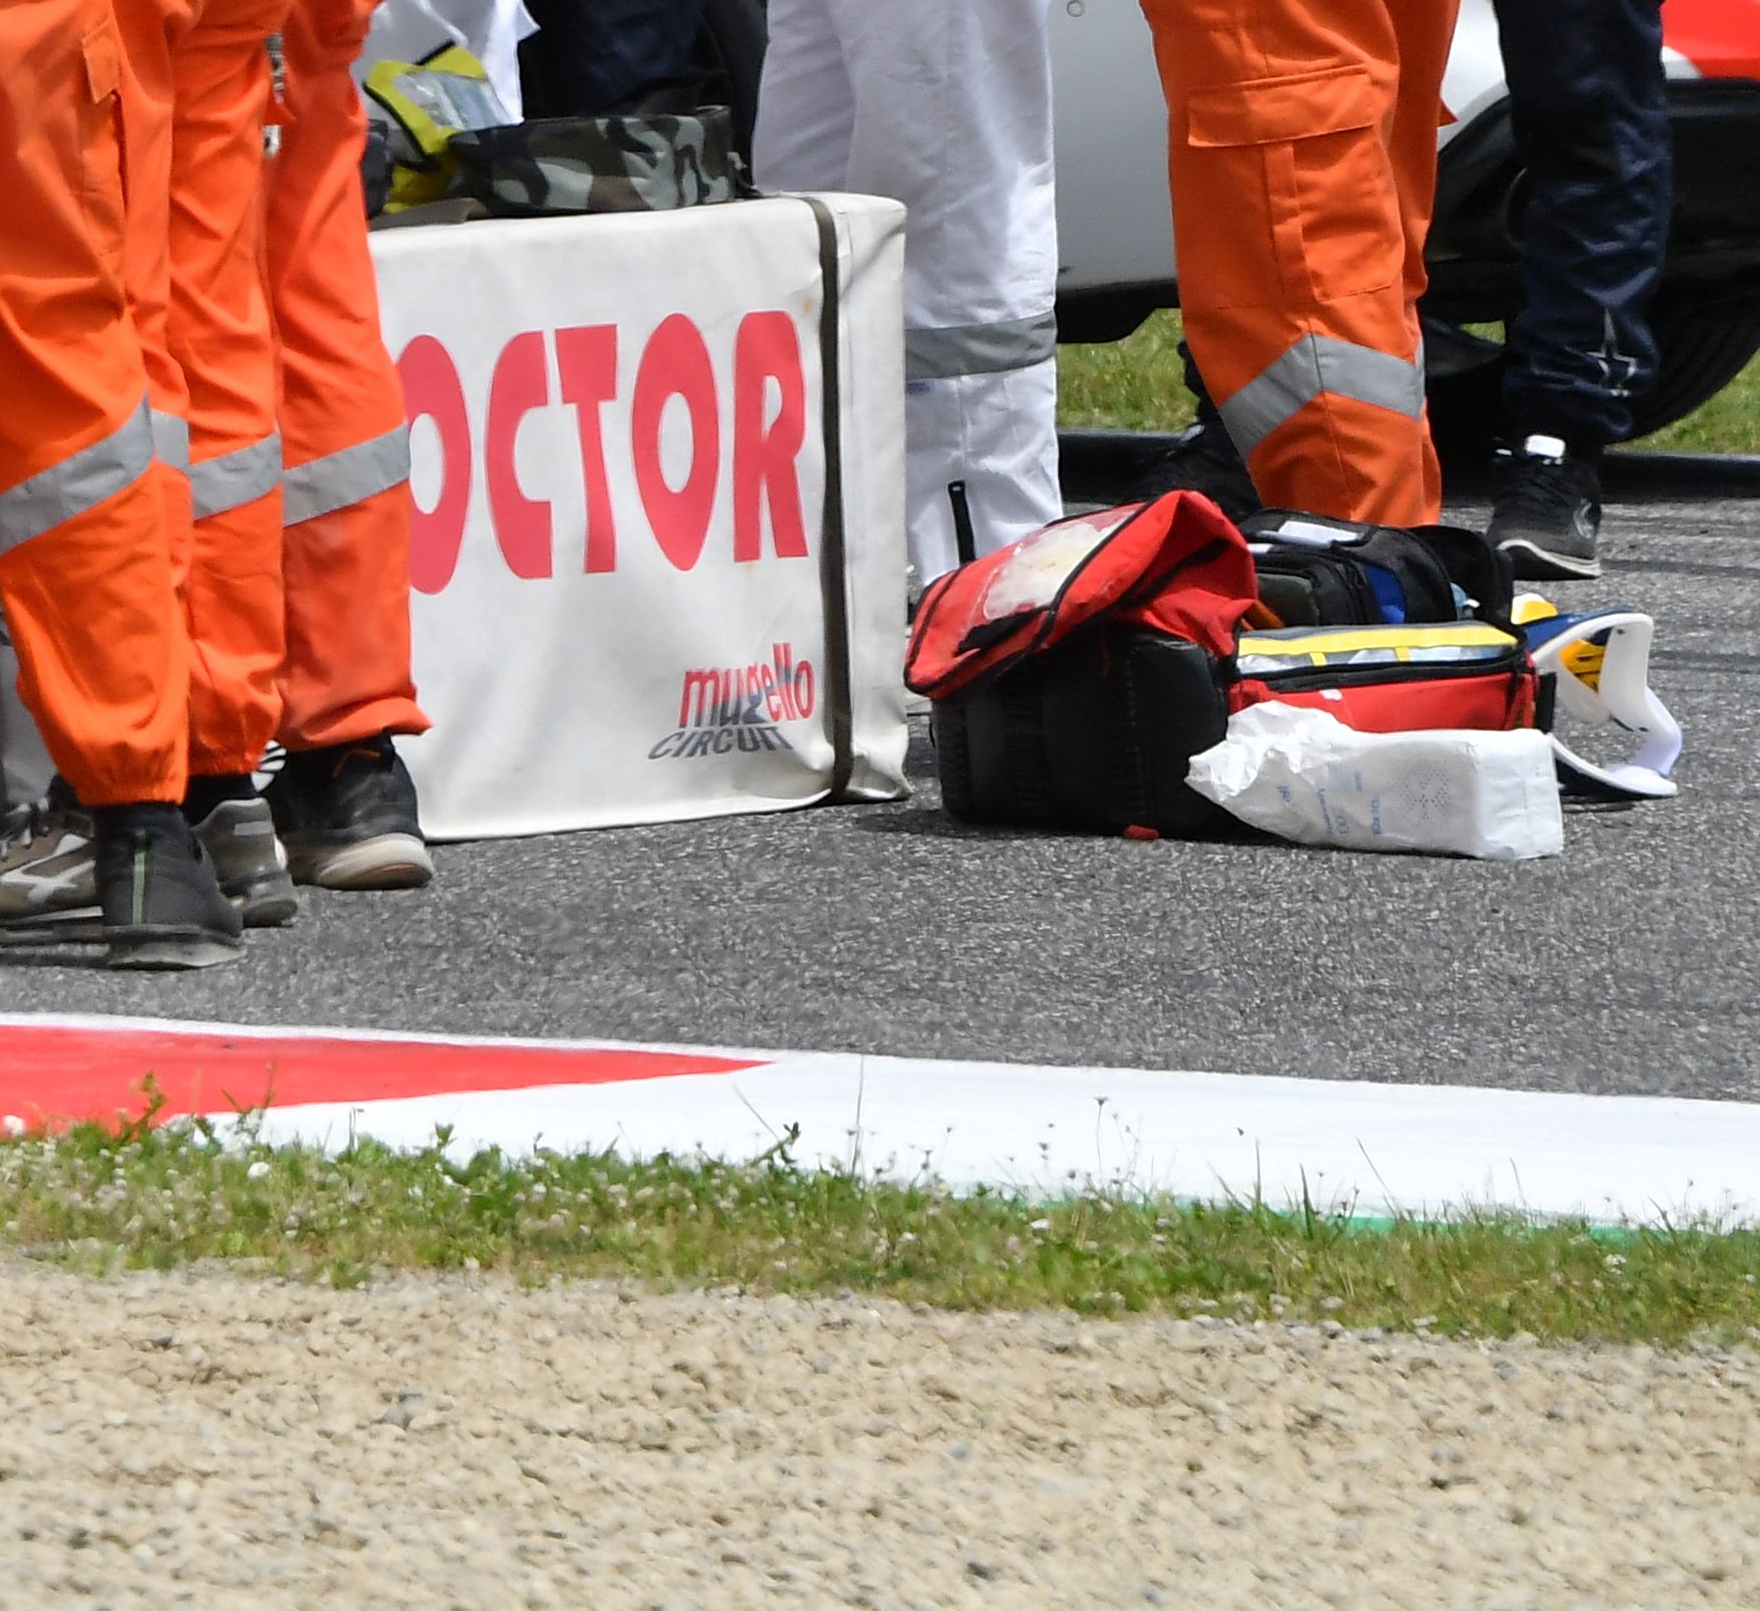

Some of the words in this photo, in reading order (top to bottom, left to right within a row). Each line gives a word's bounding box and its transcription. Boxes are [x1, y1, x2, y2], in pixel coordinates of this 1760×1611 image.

[392, 310, 809, 595] OCTOR
[678, 643, 815, 728] mugello
[648, 725, 794, 760] CIRCUIT
